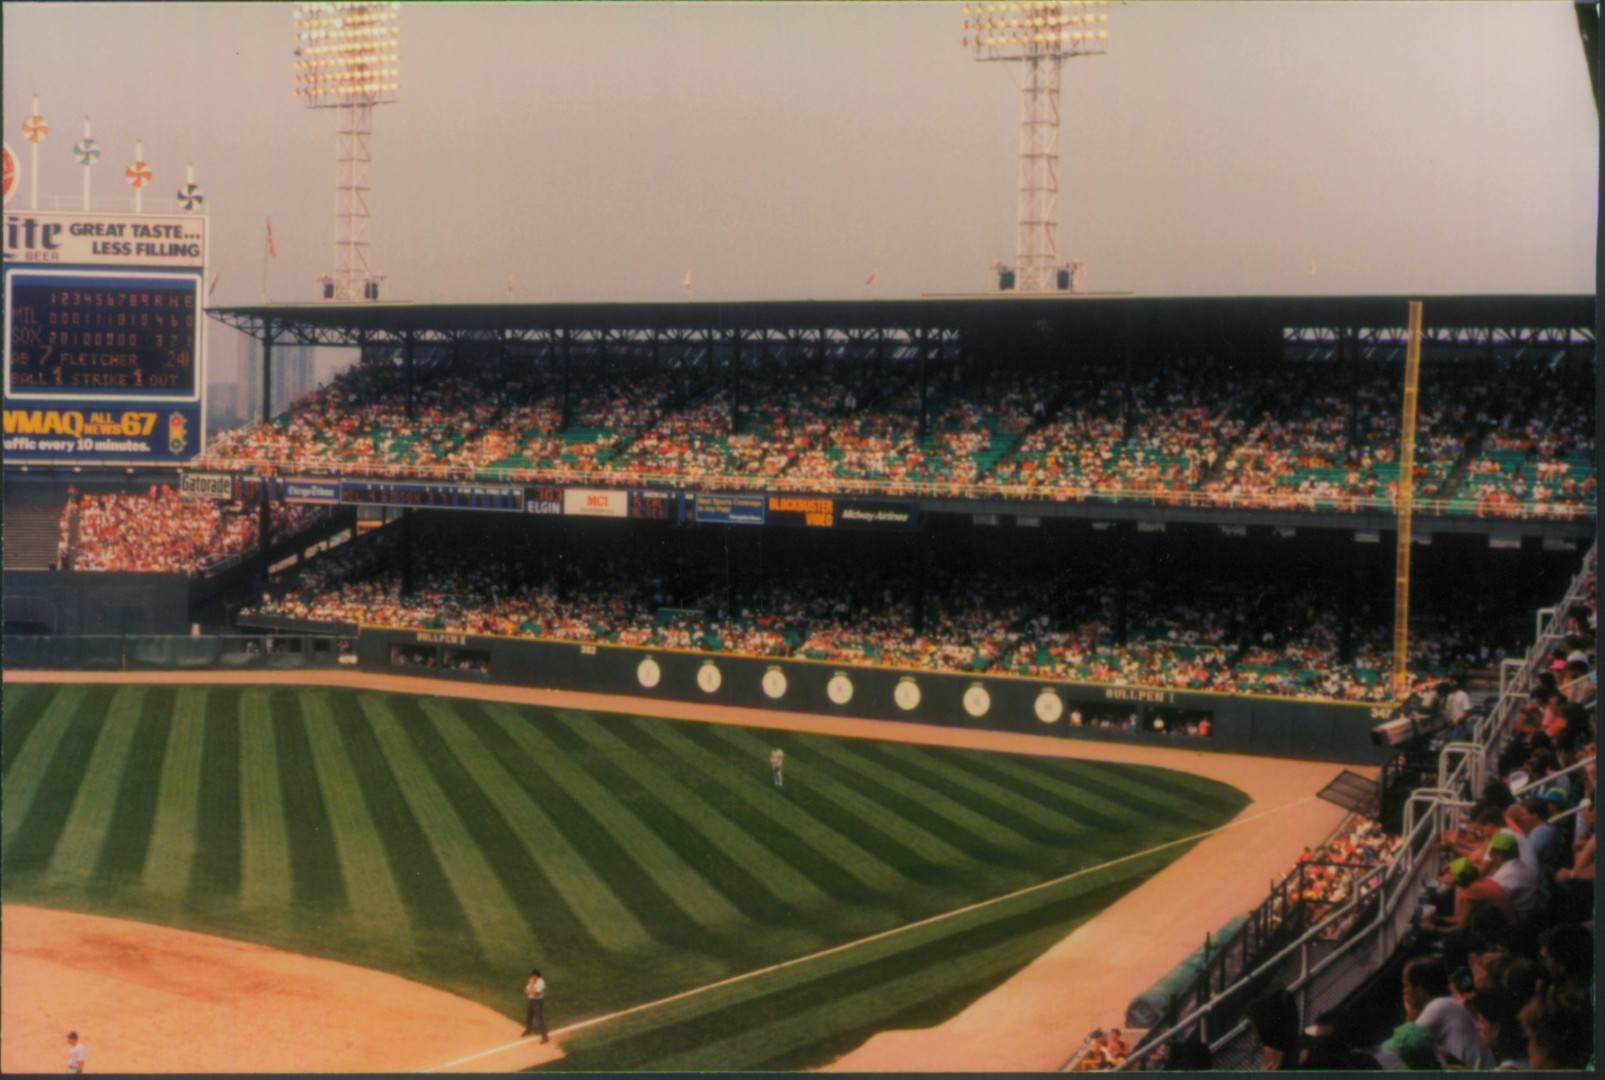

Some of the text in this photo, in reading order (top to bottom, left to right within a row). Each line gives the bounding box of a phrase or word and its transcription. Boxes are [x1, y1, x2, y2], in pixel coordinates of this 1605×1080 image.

[3, 216, 62, 256] ite
[70, 223, 200, 239] GREAT TASTE...
[26, 251, 59, 261] BEER
[92, 242, 200, 257] LESS FILLING
[12, 308, 39, 324] MIL
[12, 327, 41, 343] SOX
[39, 345, 53, 365] 7
[60, 353, 138, 367] FLETCHER
[10, 367, 179, 386] BALL 1 STRIKE 1 OUT
[90, 413, 114, 424] ALL
[121, 412, 158, 436] 67
[83, 424, 122, 435] NEWS
[3, 437, 151, 452] affic every 10 minutes.
[182, 475, 230, 493] Gatorade
[528, 500, 561, 515] ELGIN
[587, 495, 609, 507] MCI
[769, 497, 833, 512] BLOCKBUSTER
[805, 512, 833, 526] VIDEO
[842, 508, 909, 522] Midway Airlines
[416, 631, 458, 645] BULLPEN
[1105, 688, 1164, 702] BULLPEN
[1370, 707, 1393, 719] 347
